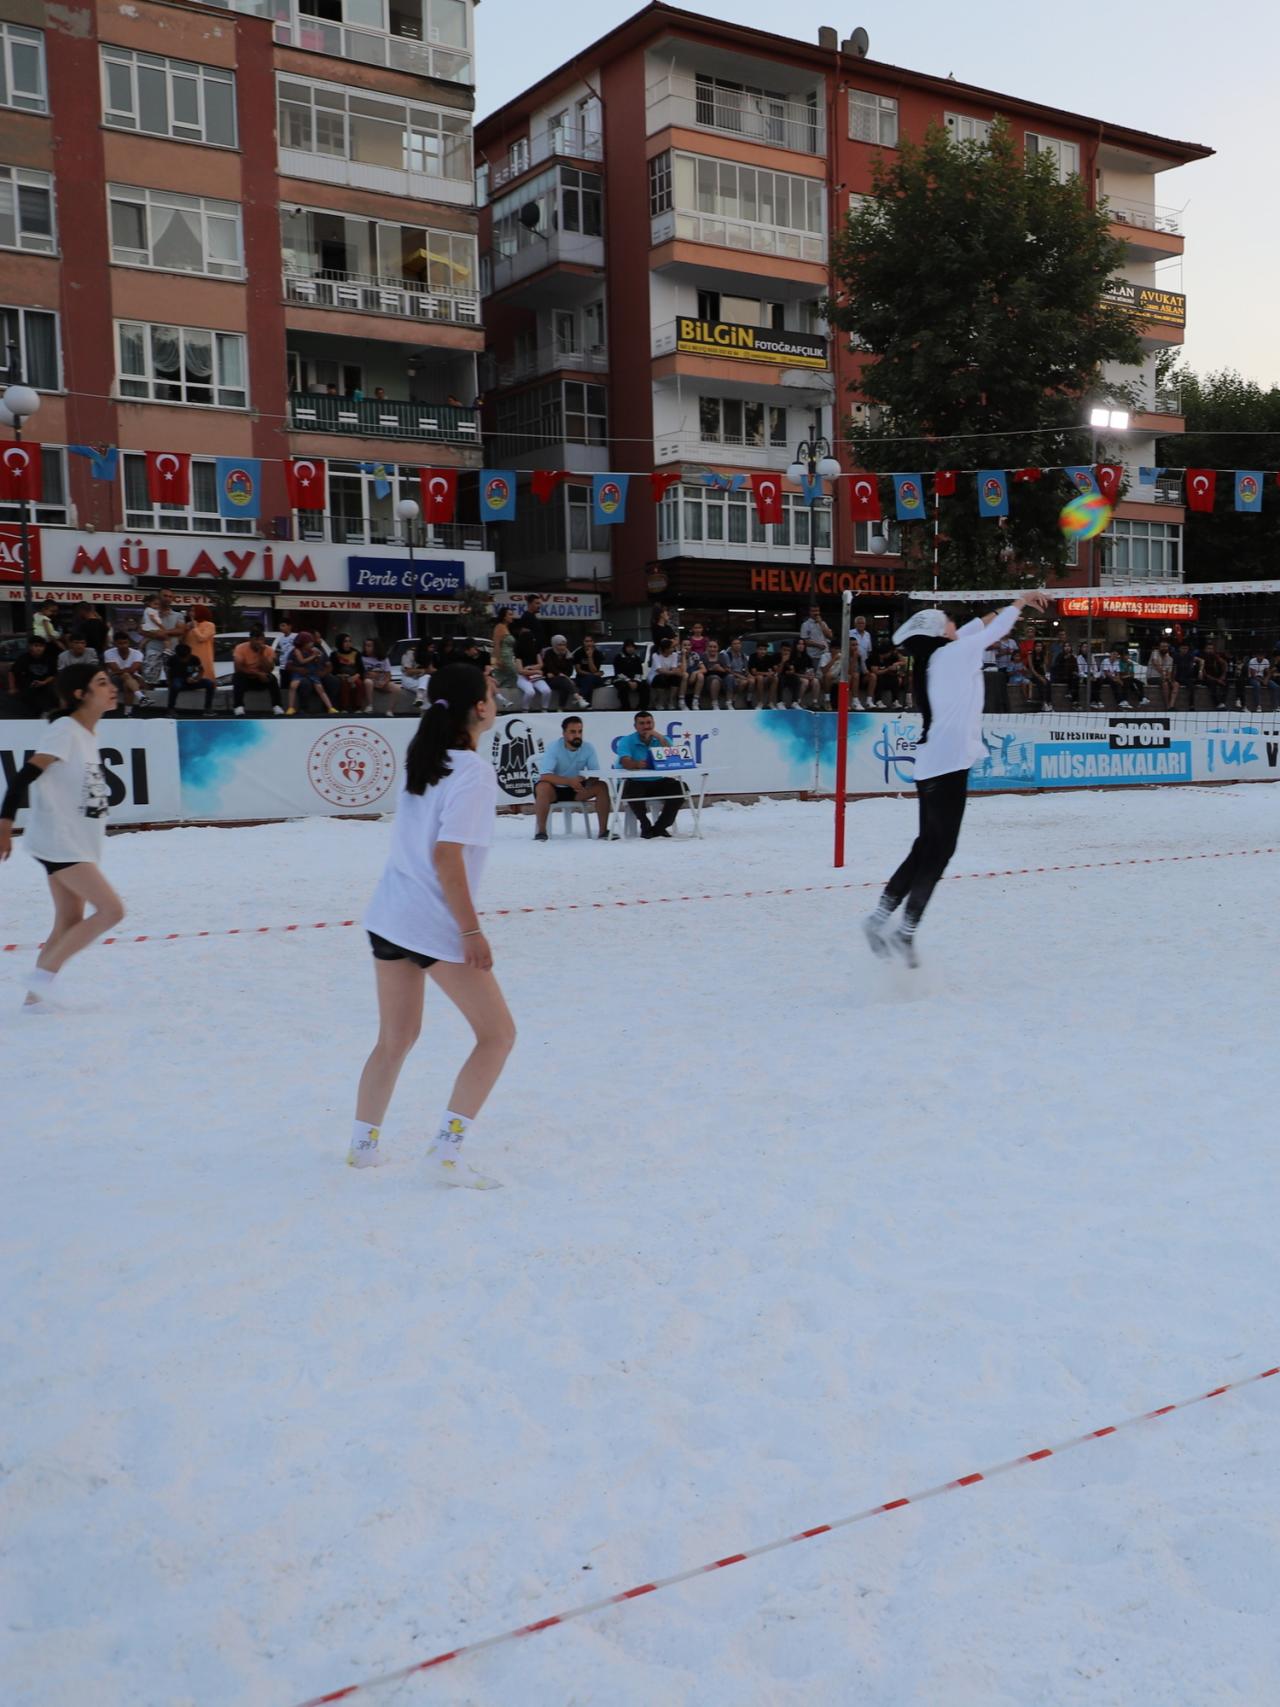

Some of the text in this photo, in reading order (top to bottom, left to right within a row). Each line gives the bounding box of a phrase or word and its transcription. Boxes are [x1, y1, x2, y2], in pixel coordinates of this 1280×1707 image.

[1140, 290, 1184, 307] AVUKAT
[754, 340, 824, 357] FOTOĞRAFÇILIK
[72, 538, 317, 582] MÜLAYİM
[356, 569, 398, 586] Perde
[420, 571, 459, 592] Çeyiz
[751, 568, 896, 597] HELVACIOĞLU
[9, 591, 143, 603] MLAYİM PERDE
[299, 599, 361, 609] MÜLAYİM
[368, 602, 409, 611] PERDE
[419, 603, 428, 611] &
[510, 594, 579, 604] GVEN
[540, 604, 594, 617] KADAYIF
[1103, 600, 1194, 617] KARATAŞ KURUYEMİŞ
[1115, 722, 1164, 747] SPOR
[895, 737, 917, 751] fes
[655, 749, 663, 760] 6
[681, 747, 690, 759] 2
[1040, 750, 1187, 779] MÜSABAKALARI
